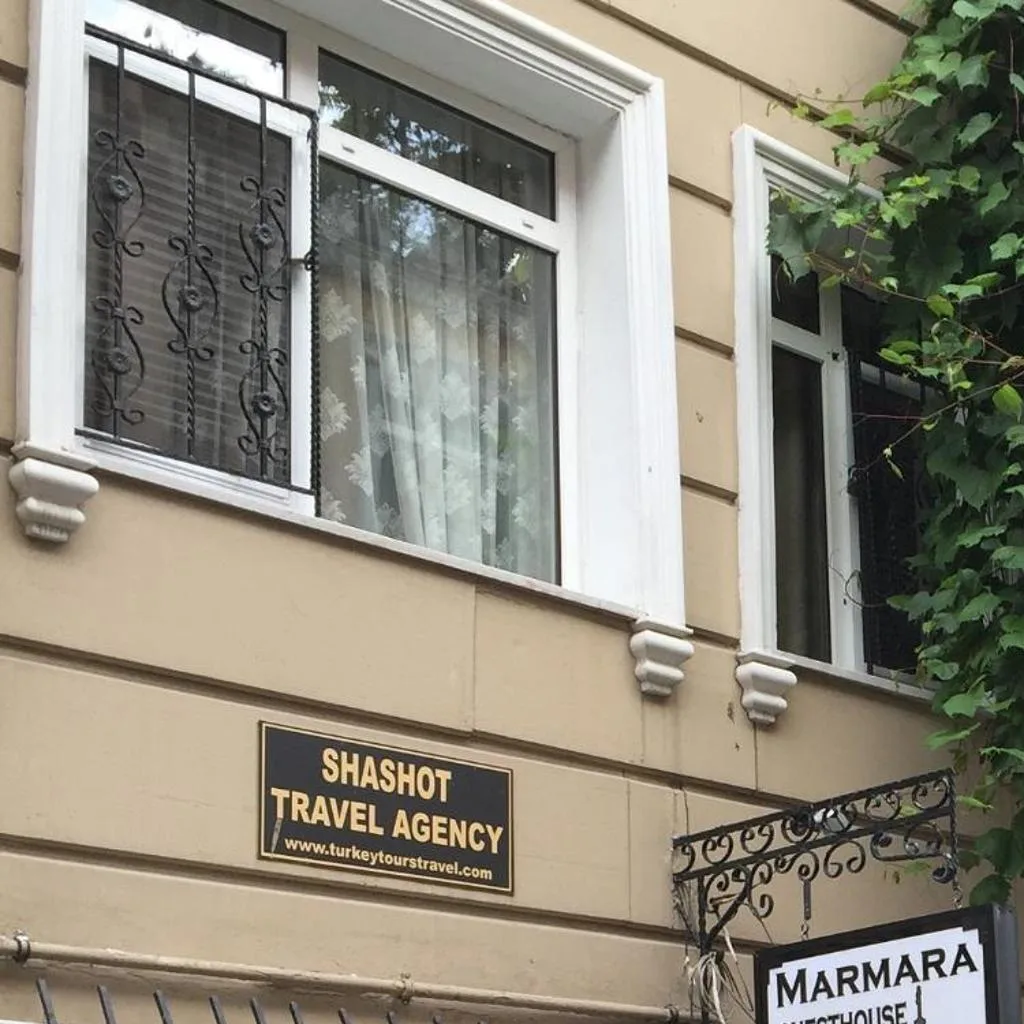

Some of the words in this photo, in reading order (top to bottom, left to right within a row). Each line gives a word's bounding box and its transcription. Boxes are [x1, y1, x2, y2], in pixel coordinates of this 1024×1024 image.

[322, 748, 452, 803] SHASHOT
[271, 787, 384, 836] TRAVEL
[392, 809, 504, 855] AGENCY
[284, 837, 493, 880] www.turkeytourstravel.com
[775, 943, 978, 1008] MARMARA
